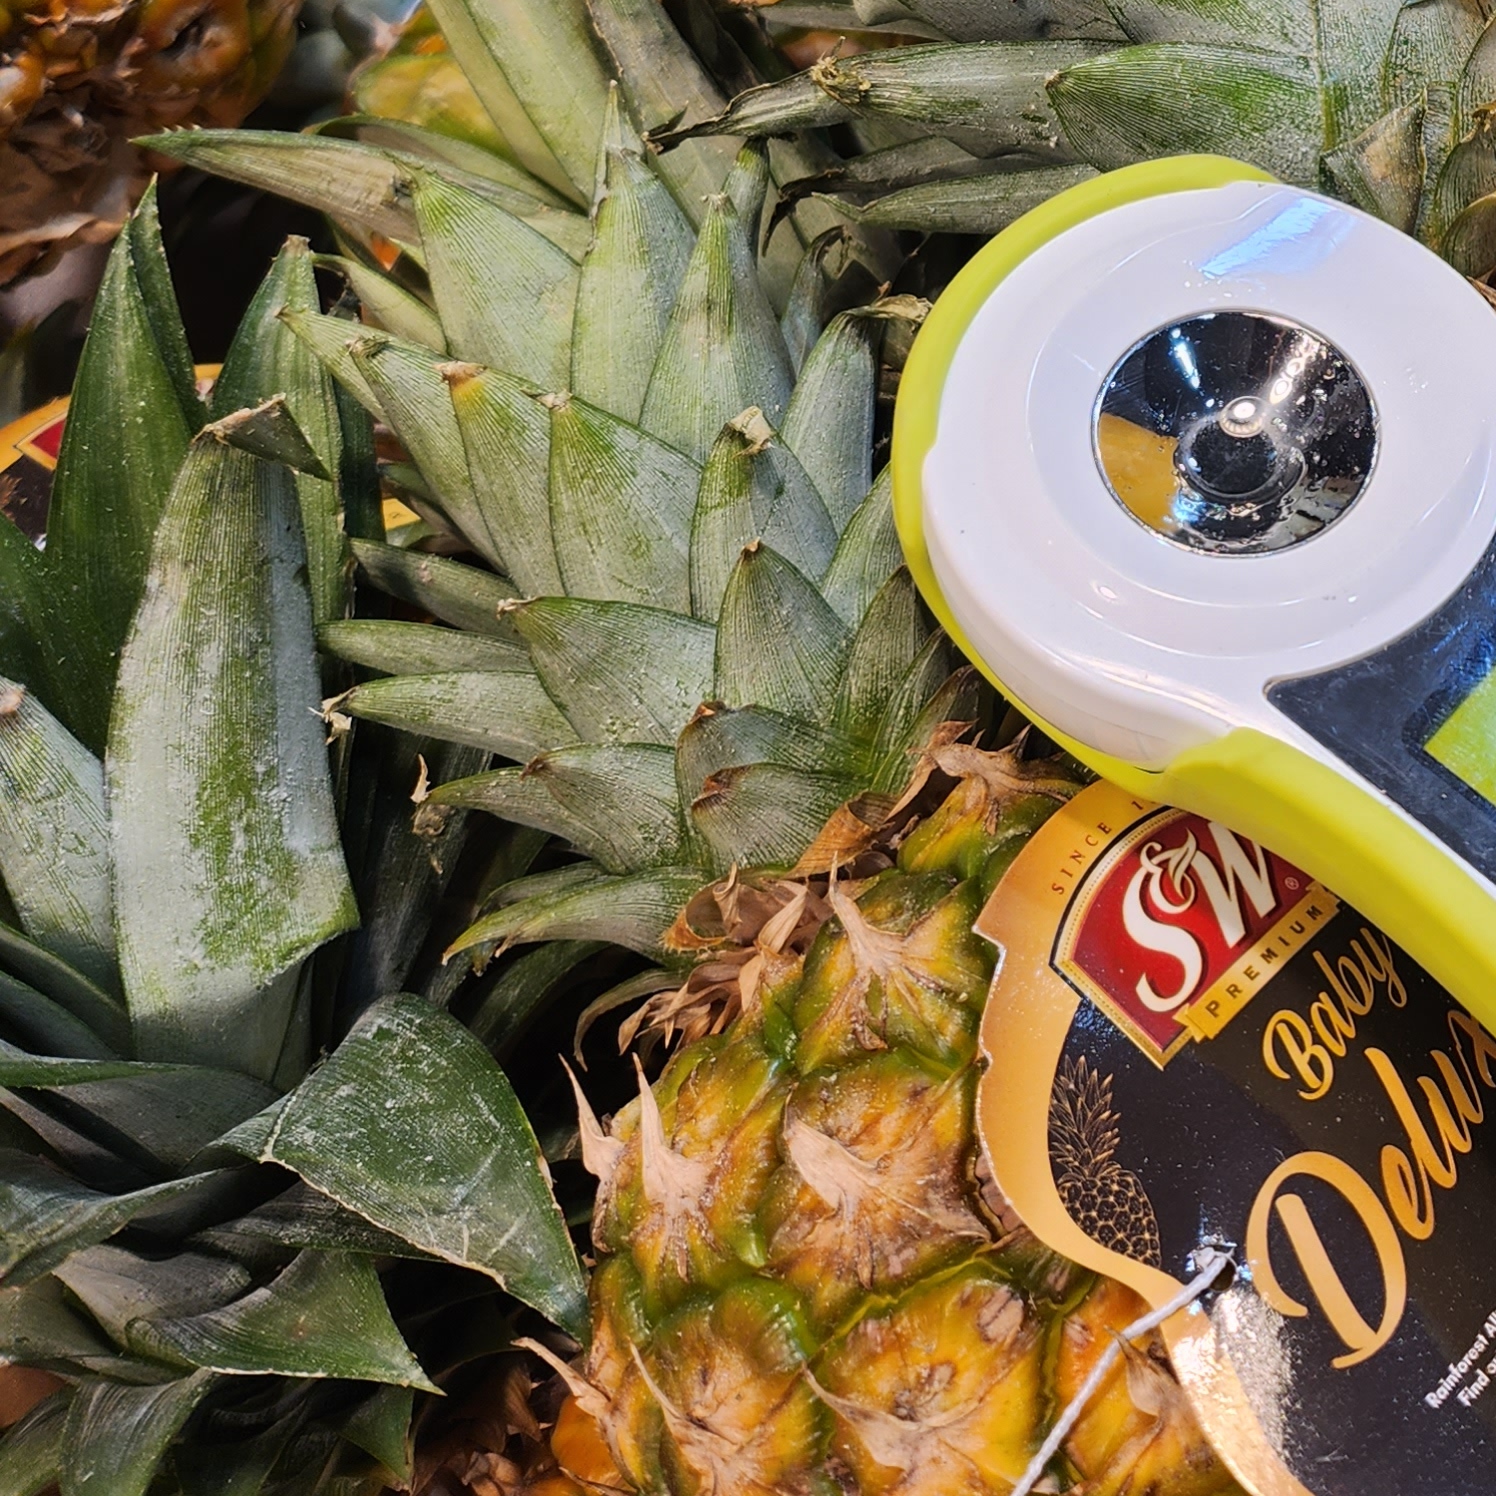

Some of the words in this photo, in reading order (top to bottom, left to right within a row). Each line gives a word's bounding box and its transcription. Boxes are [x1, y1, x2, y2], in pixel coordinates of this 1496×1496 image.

[1052, 821, 1111, 896] SINCE
[1205, 905, 1323, 1018] PREMIUM
[1263, 927, 1407, 1101] Baby
[1424, 1333, 1489, 1409] Rainforest
[1457, 1369, 1491, 1407] Find
